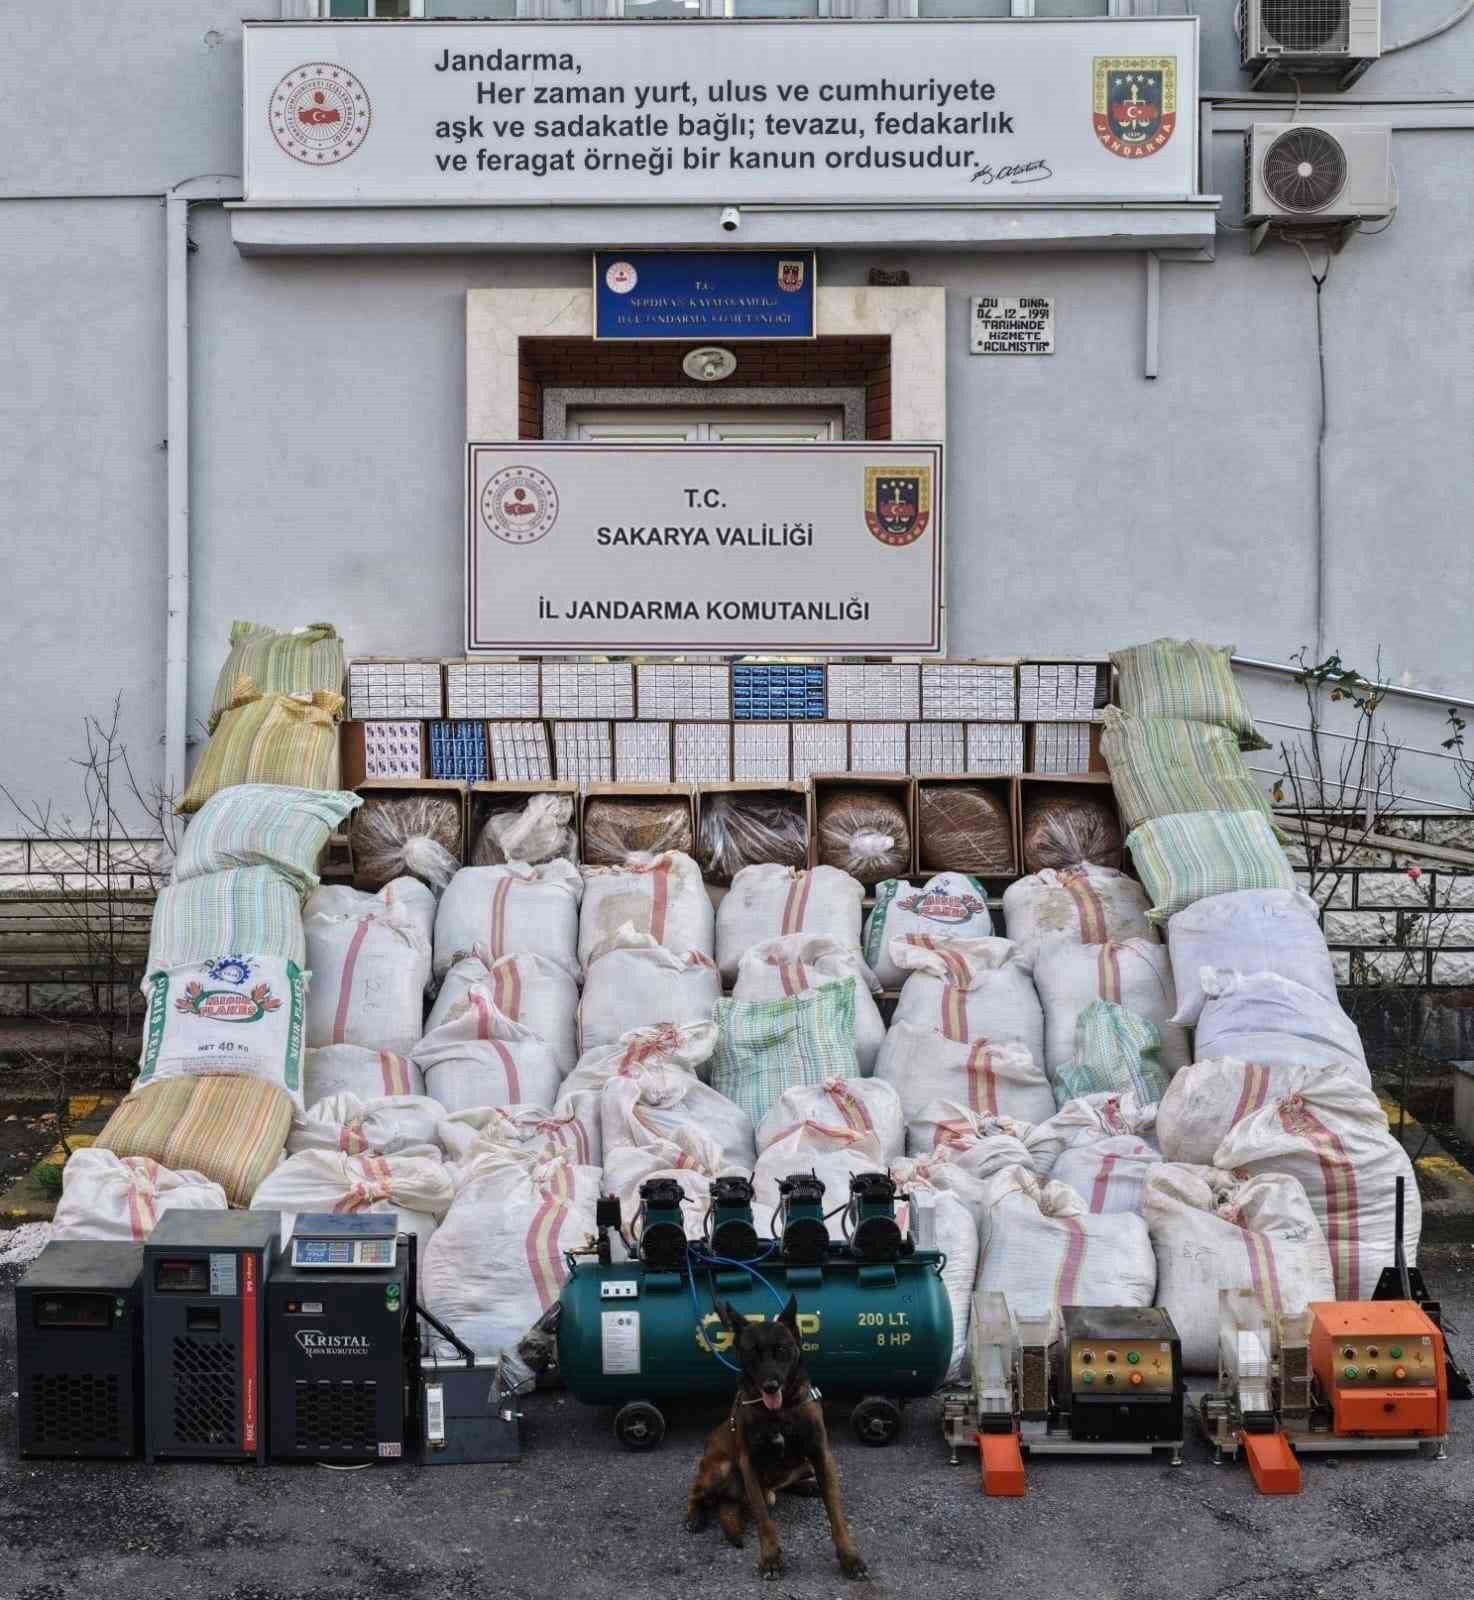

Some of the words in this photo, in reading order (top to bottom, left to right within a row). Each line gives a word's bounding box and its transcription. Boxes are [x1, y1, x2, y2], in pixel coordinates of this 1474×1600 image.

[434, 48, 582, 75] Jandarma,
[477, 81, 526, 105] Her
[533, 86, 625, 105] zaman
[634, 82, 698, 109] yurt,
[708, 79, 768, 103] ulus
[776, 84, 809, 102] ve
[819, 78, 996, 107] cumhuriyete
[435, 115, 484, 143] aşk
[492, 120, 525, 138] ve
[534, 113, 669, 138] sadakatle
[678, 112, 755, 142] bağlı;
[764, 114, 865, 139] tevazu,
[874, 111, 1014, 135] fedakarlık
[435, 154, 468, 172] ve
[476, 148, 575, 177] feragat
[584, 146, 673, 176] örneği
[683, 146, 721, 170] bir
[729, 146, 815, 169] kanun
[825, 145, 981, 169] ordusudur.
[683, 488, 727, 508] T.C.
[596, 526, 710, 547] SAKARYA
[715, 522, 814, 547] VALİLİĞİ
[538, 595, 559, 620] İL
[565, 600, 700, 621] JANDARMA
[706, 596, 870, 621] KOMUTANLIĞI
[858, 1313, 884, 1326] 200
[889, 1313, 909, 1326] LT.
[304, 1334, 369, 1346] KRISTAL
[877, 1333, 885, 1346] 8
[890, 1333, 912, 1346] HP
